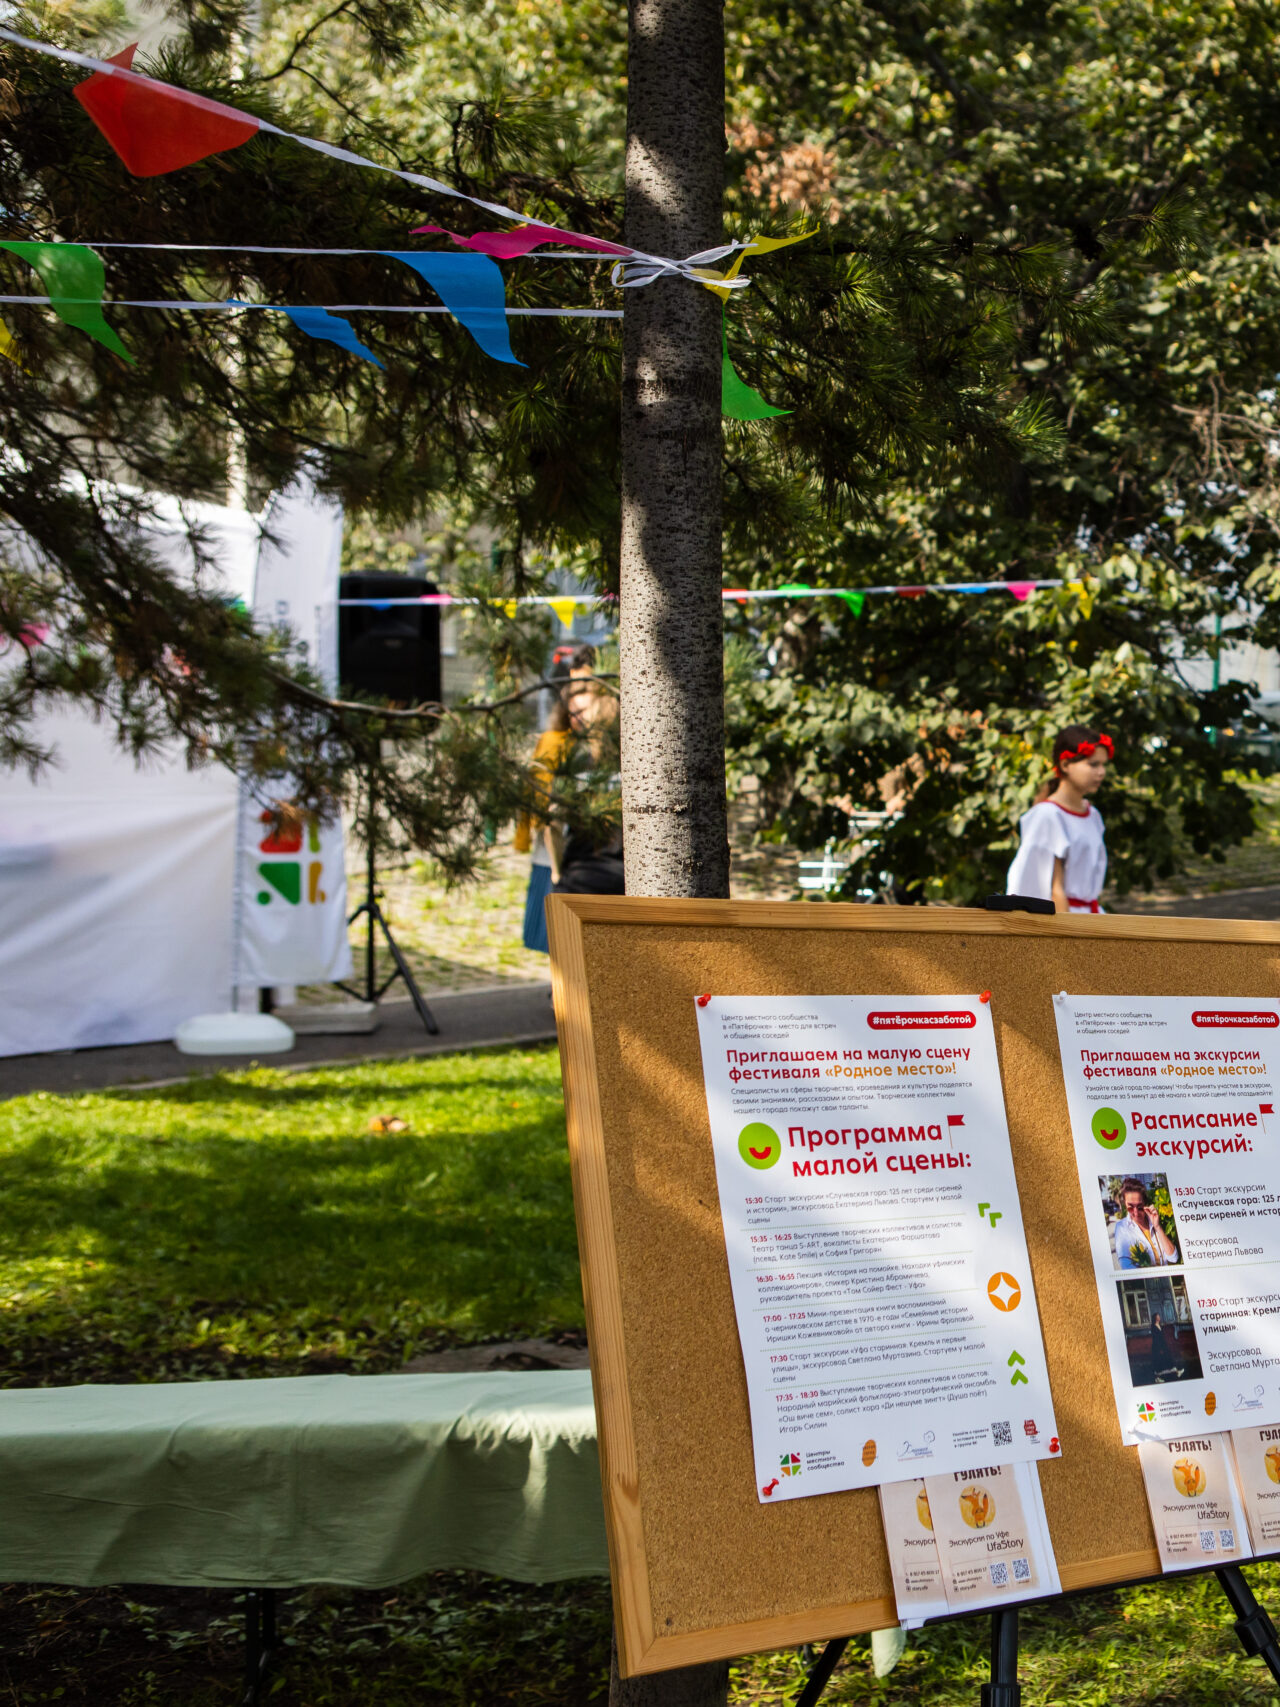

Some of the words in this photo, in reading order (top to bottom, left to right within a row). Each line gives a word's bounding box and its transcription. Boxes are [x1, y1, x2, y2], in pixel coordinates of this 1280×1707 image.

[872, 1014, 971, 1026] #пятёрочкасзаботой
[1196, 1014, 1275, 1024] #пятёрочкасзаботой
[726, 1049, 837, 1066] Приглашаем
[842, 1049, 862, 1060] на
[867, 1048, 921, 1062] малую
[926, 1047, 970, 1060] сцену
[1080, 1049, 1170, 1064] Приглашаем
[1173, 1050, 1190, 1060] на
[1193, 1050, 1260, 1063] экскурсии
[728, 1066, 820, 1083] фестиваля
[825, 1064, 892, 1079] «Родное
[897, 1061, 956, 1075] место»!
[1082, 1064, 1156, 1080] фестиваля
[1160, 1064, 1214, 1077] «Родное
[1218, 1063, 1266, 1075] место»!
[1130, 1111, 1257, 1130] Расписание
[787, 1124, 942, 1152] Программа
[1135, 1132, 1252, 1160] экскурсий:
[792, 1151, 878, 1177] малой
[886, 1151, 971, 1174] сцены:
[1174, 1186, 1195, 1196] 15:30
[1196, 1186, 1221, 1196] Старт
[1223, 1184, 1265, 1194] экскурсии
[1177, 1198, 1234, 1209] «Случевская
[1236, 1196, 1260, 1206] гора:
[1261, 1194, 1274, 1203] 125
[1179, 1213, 1207, 1223] среди
[1208, 1208, 1247, 1221] сиреней
[1184, 1235, 1239, 1247] Экскурсовод
[1187, 1249, 1232, 1260] Екатерина
[1234, 1246, 1263, 1256] Львова
[762, 1314, 781, 1322] 17:00
[788, 1311, 805, 1320] 17:25
[806, 1306, 874, 1318] Мини-презентация
[896, 1297, 946, 1310] воспоминаний
[1196, 1298, 1217, 1308] 17:30
[1218, 1296, 1243, 1306] Старт
[1199, 1309, 1252, 1321] старинная:
[766, 1334, 796, 1343] Иришки
[797, 1327, 853, 1339] Кожевниковой»
[864, 1324, 889, 1332] автора
[916, 1319, 939, 1327] Ирины
[940, 1314, 974, 1325] Фроловой
[1202, 1324, 1238, 1336] улицы».
[770, 1354, 788, 1362] 17:30
[789, 1352, 810, 1361] Старт
[813, 1348, 849, 1358] экскурсии
[850, 1346, 868, 1354] «Уфа
[909, 1339, 934, 1348] Кремль
[941, 1335, 966, 1344] первые
[802, 1358, 846, 1369] экскурсовод
[847, 1354, 881, 1364] Светлана
[923, 1346, 957, 1356] Стартуем
[963, 1341, 985, 1350] малой
[1207, 1346, 1262, 1360] Экскурсовод
[1209, 1361, 1250, 1373] Светлана
[772, 1375, 796, 1383] сцены
[775, 1392, 793, 1402] 17:35
[800, 1389, 818, 1398] 18:30
[819, 1385, 865, 1396] Выступление
[866, 1380, 906, 1390] творческих
[907, 1375, 950, 1385] коллективов
[776, 1400, 815, 1413] Народный
[817, 1395, 857, 1407] марийский
[858, 1382, 962, 1403] фольклорно-этнографический
[963, 1378, 996, 1389] ансамбль
[779, 1425, 802, 1433] Игорь
[803, 1421, 827, 1430] Силин
[1168, 1439, 1212, 1453] ГУЛЯТЬ!
[953, 1465, 1002, 1482] ГУЛЯТЬ!
[1197, 1509, 1230, 1520] UfaStory
[904, 1538, 936, 1548] Экскурси
[986, 1538, 1024, 1552] UfaStory
